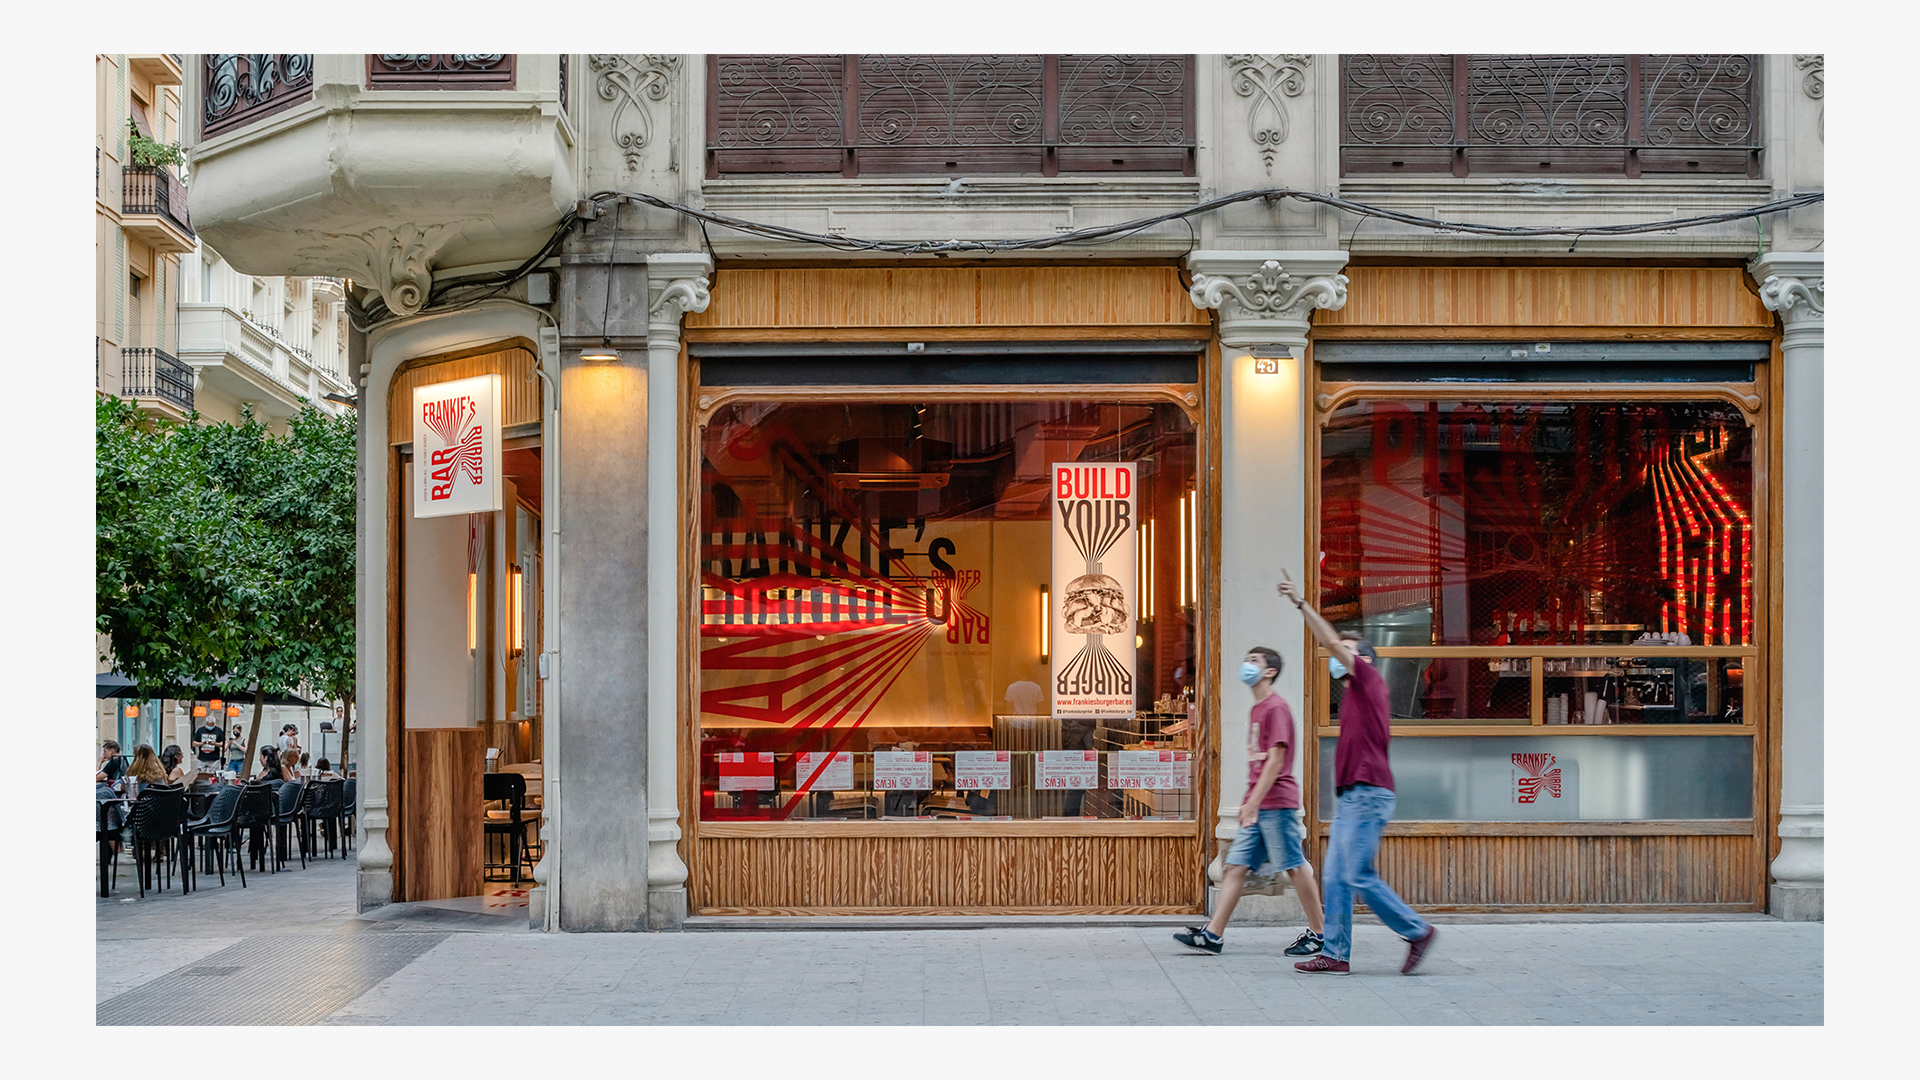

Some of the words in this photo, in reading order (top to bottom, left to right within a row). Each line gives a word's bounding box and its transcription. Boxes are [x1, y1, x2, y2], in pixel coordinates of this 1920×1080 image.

[1257, 359, 1276, 373] 45
[467, 425, 483, 486] BURGER
[431, 447, 453, 501] BAR
[1057, 468, 1131, 499] BUILD
[1057, 500, 1131, 541] YOUR
[946, 611, 990, 645] BAR
[1056, 665, 1132, 695] BURGER
[1056, 698, 1133, 707] www.frankiesburgerbar.es
[875, 778, 897, 789] NEWS
[957, 778, 979, 789] NEWS
[1044, 777, 1066, 788] NEWS
[1120, 778, 1141, 788] NEWS
[1518, 777, 1537, 804] BAR
